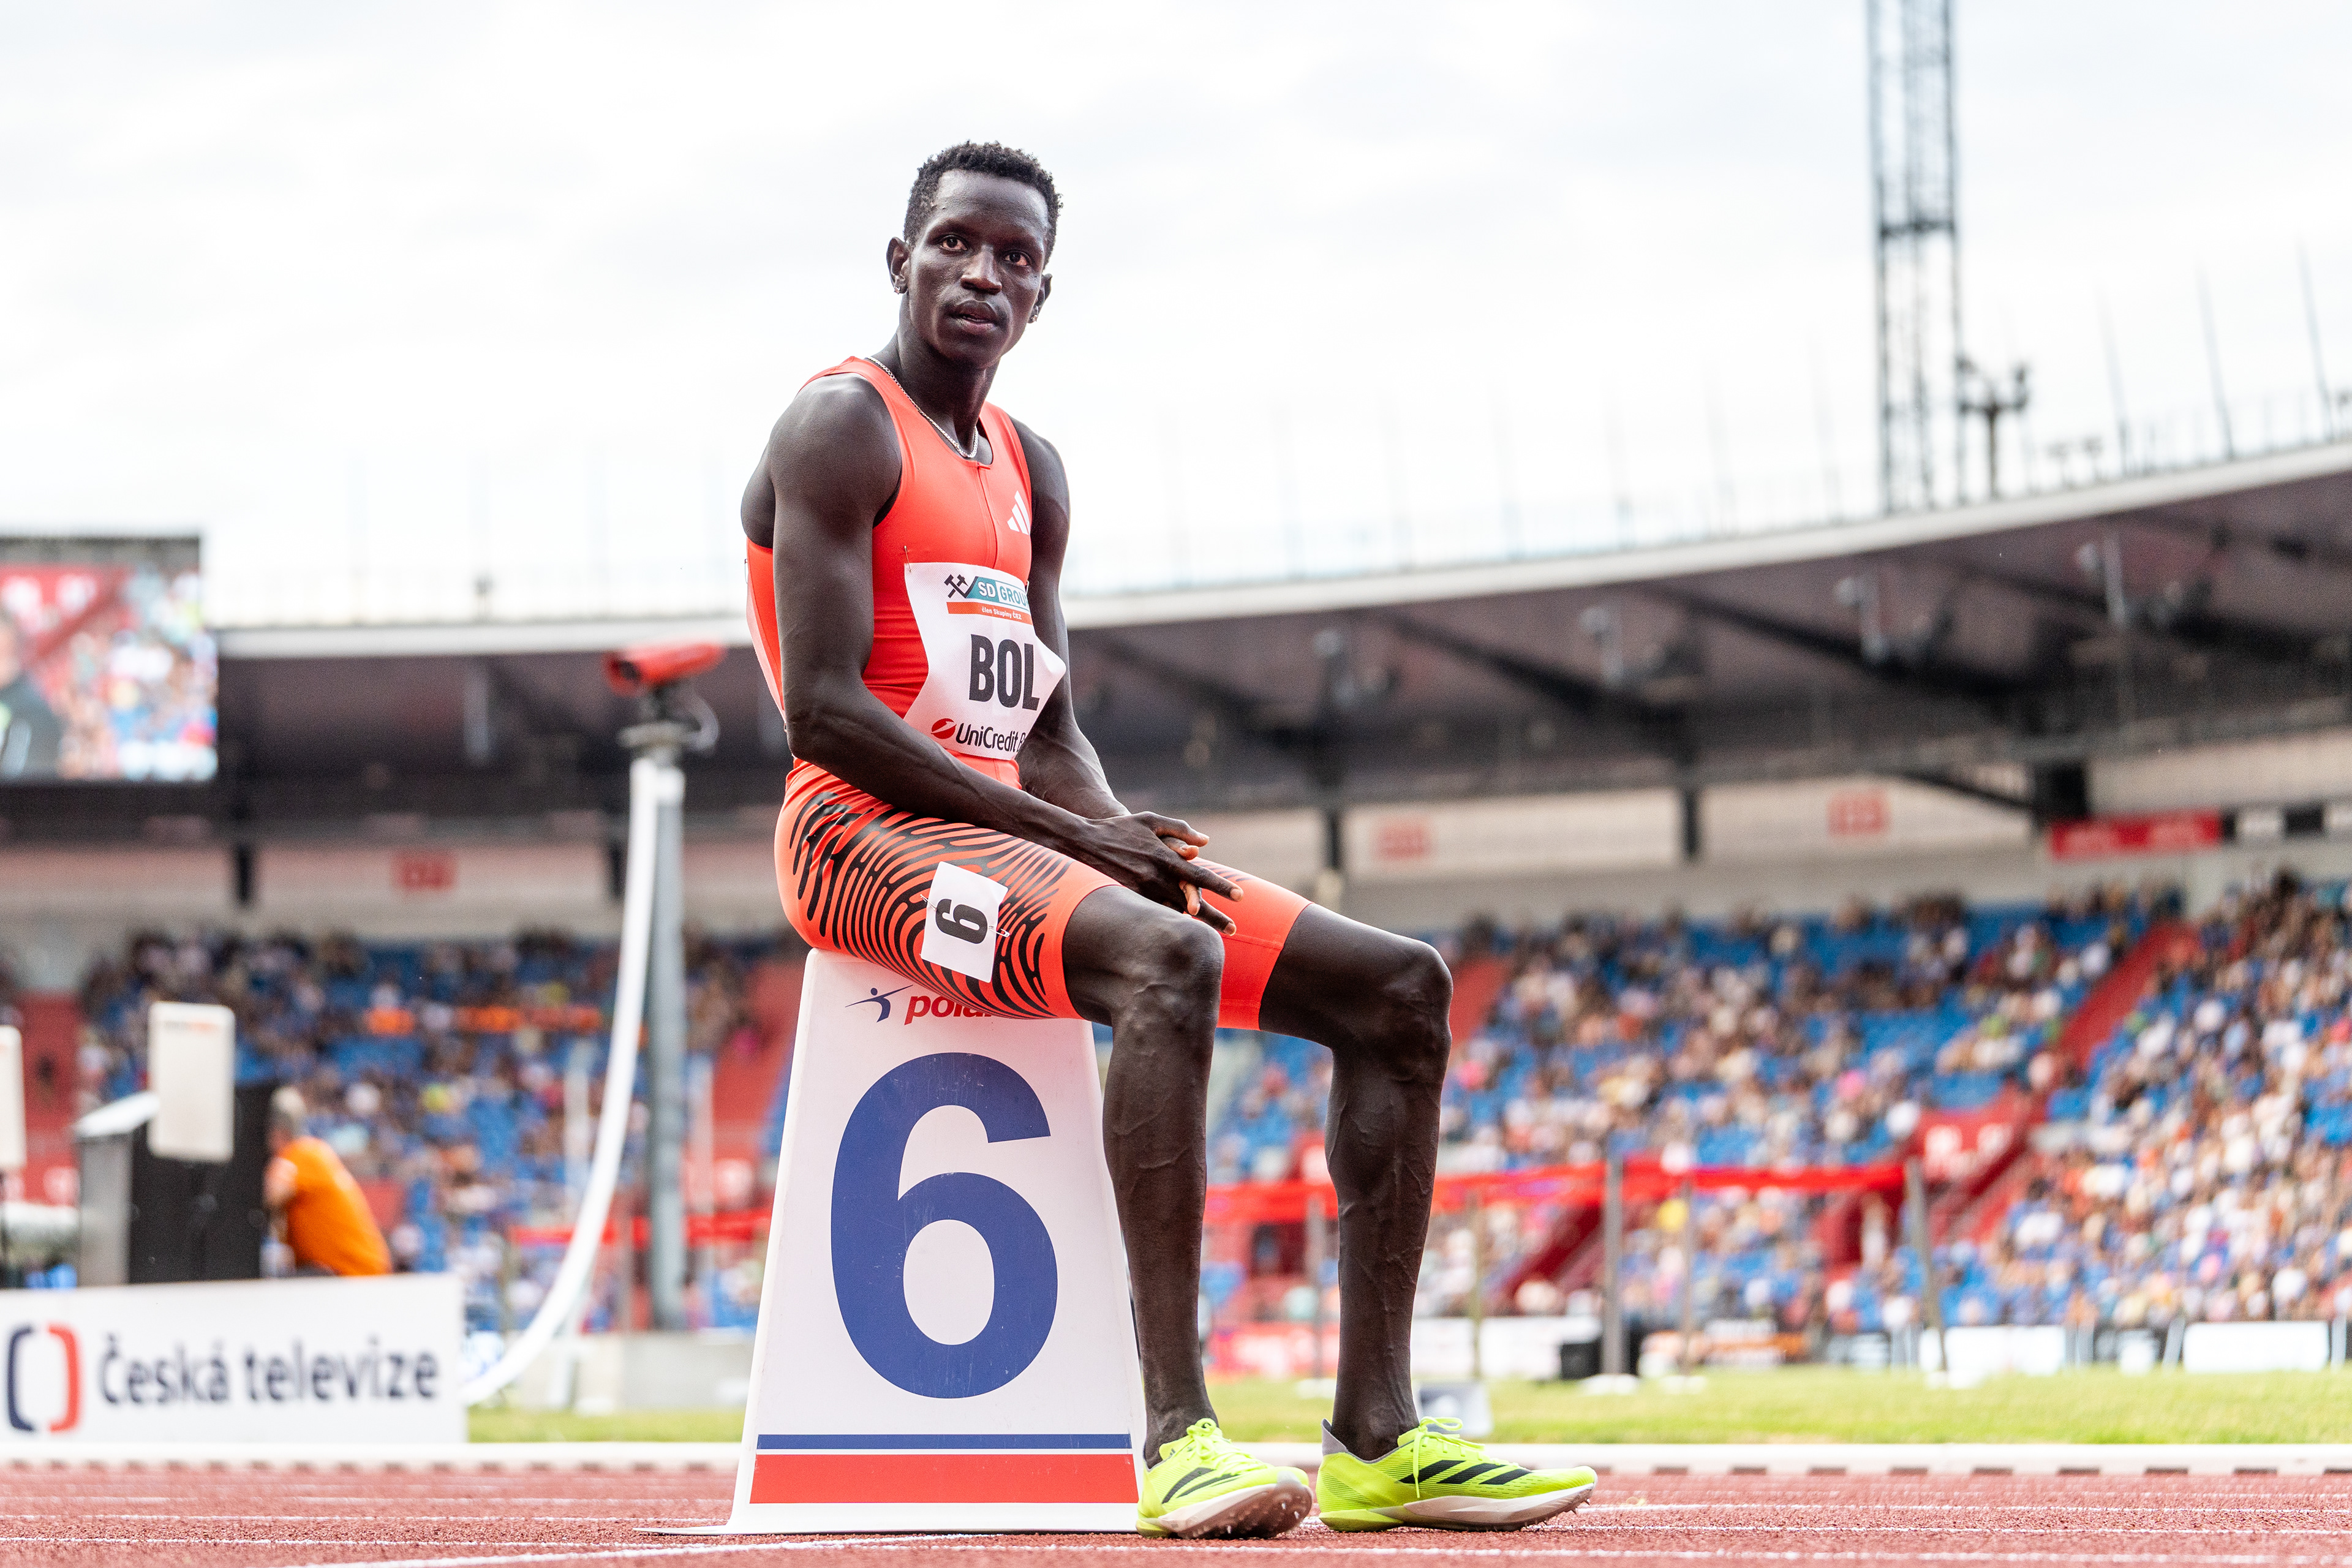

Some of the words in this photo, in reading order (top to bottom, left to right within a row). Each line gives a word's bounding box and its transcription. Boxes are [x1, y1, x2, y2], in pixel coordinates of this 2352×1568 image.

[978, 581, 996, 598] SD
[993, 609, 1012, 619] Skupiny
[1012, 611, 1022, 620] ČEZ
[969, 635, 1039, 710] BOL
[956, 723, 1019, 753] UniCredit
[936, 899, 987, 944] 6
[831, 1052, 1058, 1399] 6
[99, 1330, 229, 1405] Česká
[246, 1333, 439, 1401] televize
